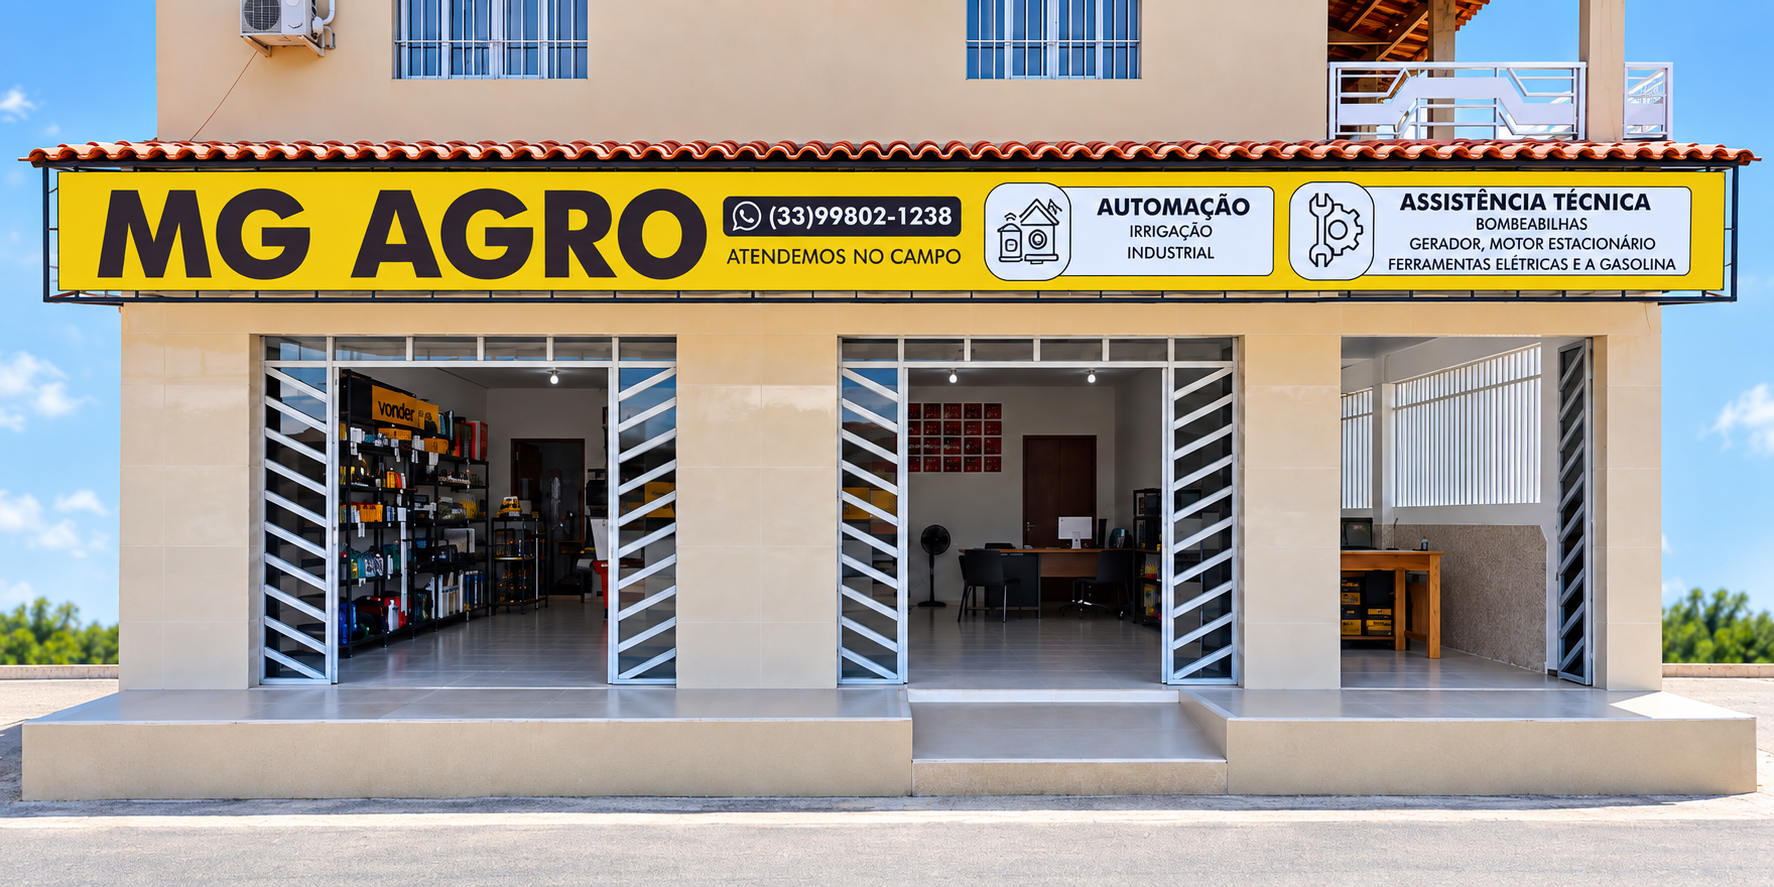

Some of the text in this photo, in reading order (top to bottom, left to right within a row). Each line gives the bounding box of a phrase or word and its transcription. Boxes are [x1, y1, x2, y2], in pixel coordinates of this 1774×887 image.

[1097, 195, 1251, 220] AUTOMAÇÃO
[1400, 189, 1651, 211] ASSISTÊNCIA TÉCNICA
[769, 205, 952, 230] (33)99802-1238
[1477, 218, 1587, 230] BOMBEABILHAS
[98, 189, 707, 280] MG AGRO
[1131, 222, 1212, 241] IRRIGAÇÃO
[1410, 234, 1655, 252] GERADOR, MOTOR ESTACIONÁRIO
[727, 249, 961, 264] ATENDEMOS NO CAMPO
[1128, 247, 1214, 259] INDUSTRIAL
[1389, 255, 1676, 270] FERRAMENTAS ELÉTRICAS E A GASOLINA
[378, 401, 415, 421] vonder
